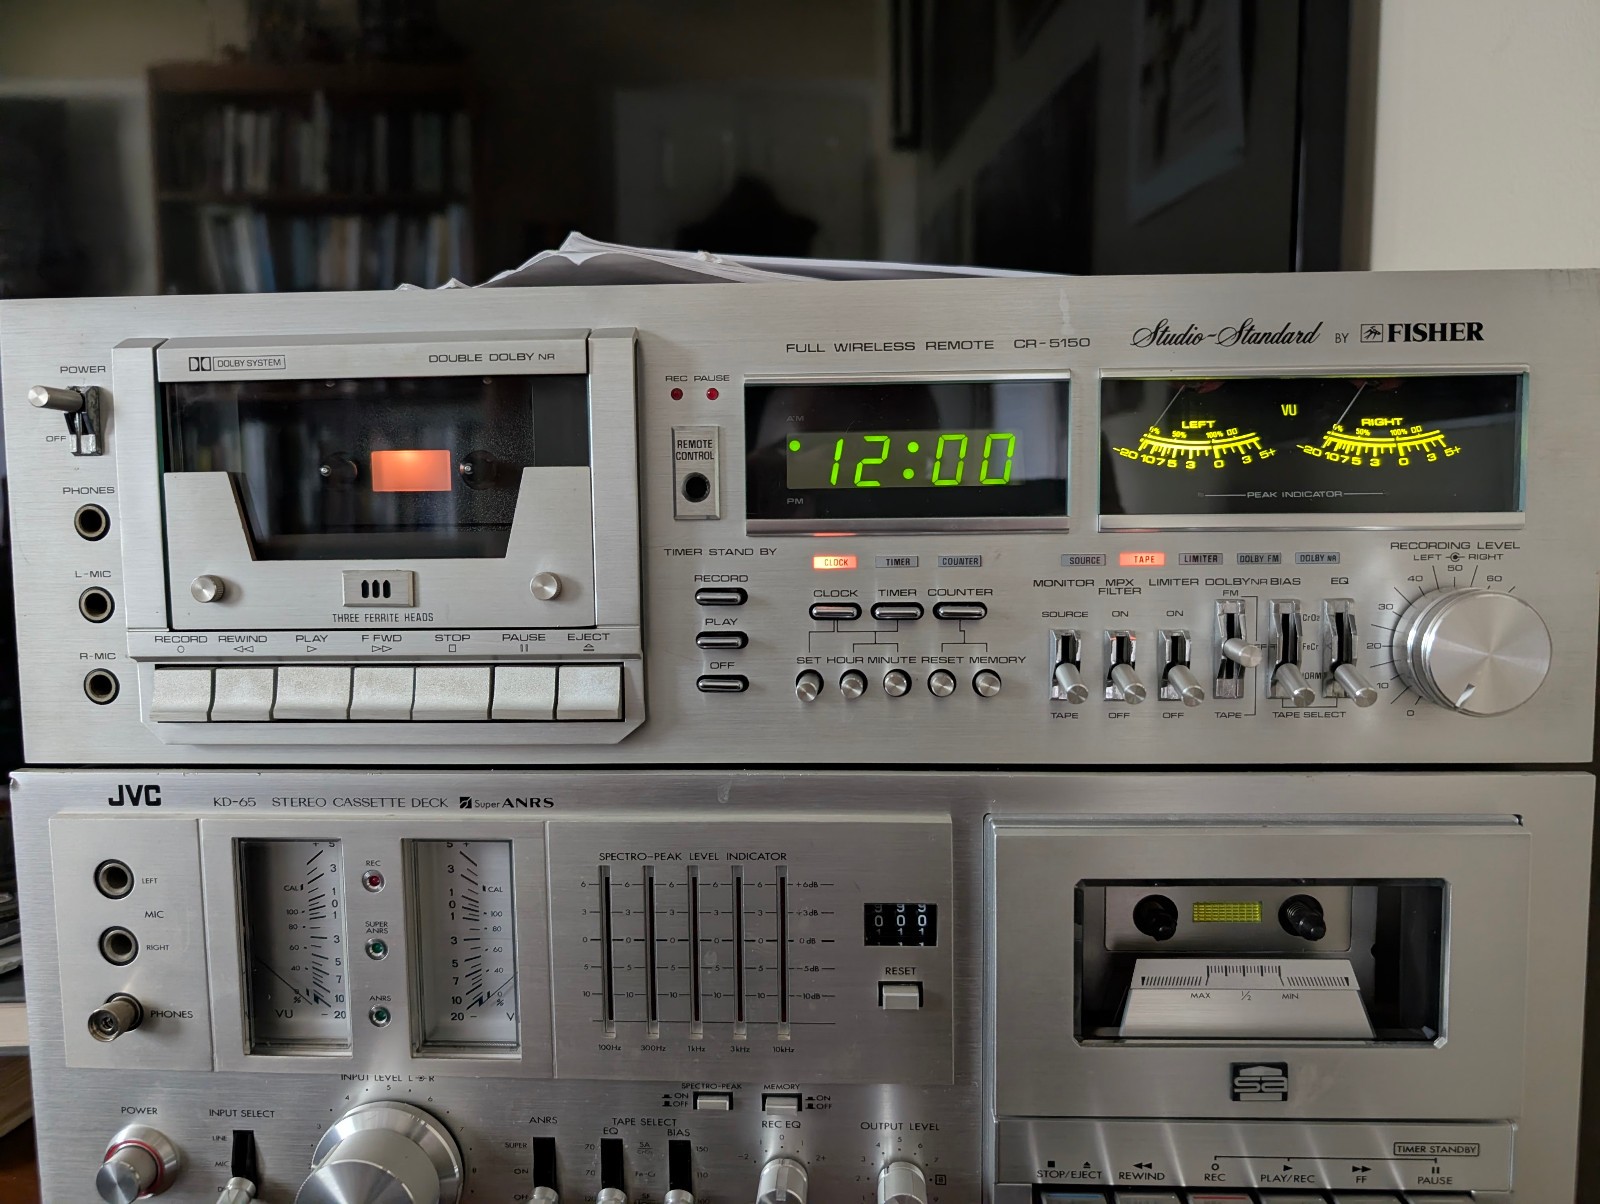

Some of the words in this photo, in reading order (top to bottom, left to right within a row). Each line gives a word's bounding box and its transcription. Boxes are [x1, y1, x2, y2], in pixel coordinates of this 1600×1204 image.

[1130, 317, 1321, 348] Studio-Standard
[1335, 333, 1350, 343] BY
[1387, 321, 1484, 342] FISHER
[786, 343, 825, 353] FULL
[834, 342, 915, 352] WIRELESS
[926, 341, 994, 350] REMOTE
[1014, 338, 1090, 349] CR-5150
[429, 353, 483, 363] DOUBLE
[489, 353, 534, 362] DOLBY
[538, 353, 555, 361] NR
[217, 360, 246, 368] DOLBY
[246, 358, 282, 367] SYSTEM
[60, 365, 106, 374] POWER
[1281, 404, 1297, 416] VU
[1182, 420, 1216, 429] LEFT
[1361, 418, 1403, 426] RIGHT
[677, 440, 713, 449] REMOTE
[675, 451, 714, 461] CONTROL
[829, 433, 1016, 487] 12:00
[62, 486, 115, 494] PHONES
[1391, 542, 1470, 550] RECORDING
[1477, 541, 1520, 549] LEVEL
[886, 558, 910, 566] TIMER
[943, 557, 979, 566] COUNTER
[1070, 557, 1100, 565] SOURCE
[1268, 554, 1279, 562] FM
[1300, 554, 1323, 562] DOLBY
[75, 570, 112, 578] L-MIC
[1033, 579, 1094, 587] MONITOR
[1205, 578, 1250, 586] DOLBY
[332, 613, 359, 622] THREE
[364, 613, 399, 622] FERRITE
[404, 612, 434, 622] HEADS
[705, 618, 738, 626] PLAY
[155, 635, 207, 643] RECORD
[218, 635, 267, 643] REWIND
[435, 634, 470, 642] STOP
[567, 633, 610, 641] EJECT
[1302, 643, 1319, 651] FeCr
[970, 656, 1026, 664] MEMORY
[108, 784, 161, 806] JVC
[213, 797, 256, 807] KD-65
[272, 797, 327, 807] STEREO
[333, 797, 405, 807] CASSETTE
[412, 797, 449, 808] DECK
[475, 800, 500, 810] Super
[502, 797, 554, 808] ANRS
[599, 853, 682, 861] SPECTRO-PEAK
[689, 853, 719, 861] LEVEL
[726, 853, 787, 861] INDICATOR
[885, 967, 917, 975] RESET
[151, 1010, 193, 1018] PHONES
[275, 1009, 294, 1018] VU
[121, 1107, 158, 1115] POWER
[209, 1109, 237, 1117] INPUT
[241, 1110, 275, 1118] SELECT
[612, 1118, 636, 1126] TAPE
[641, 1118, 677, 1127] SELECT
[860, 1122, 903, 1130] OUTPUT
[909, 1123, 939, 1131] LEVEL
[603, 1127, 619, 1135] EQ
[1430, 1146, 1477, 1154] STANDBY
[1037, 1170, 1102, 1179] STOP/EJECT
[1119, 1172, 1165, 1180] REWIND
[1205, 1173, 1226, 1181] REC
[1261, 1175, 1315, 1183] PLAY/REC
